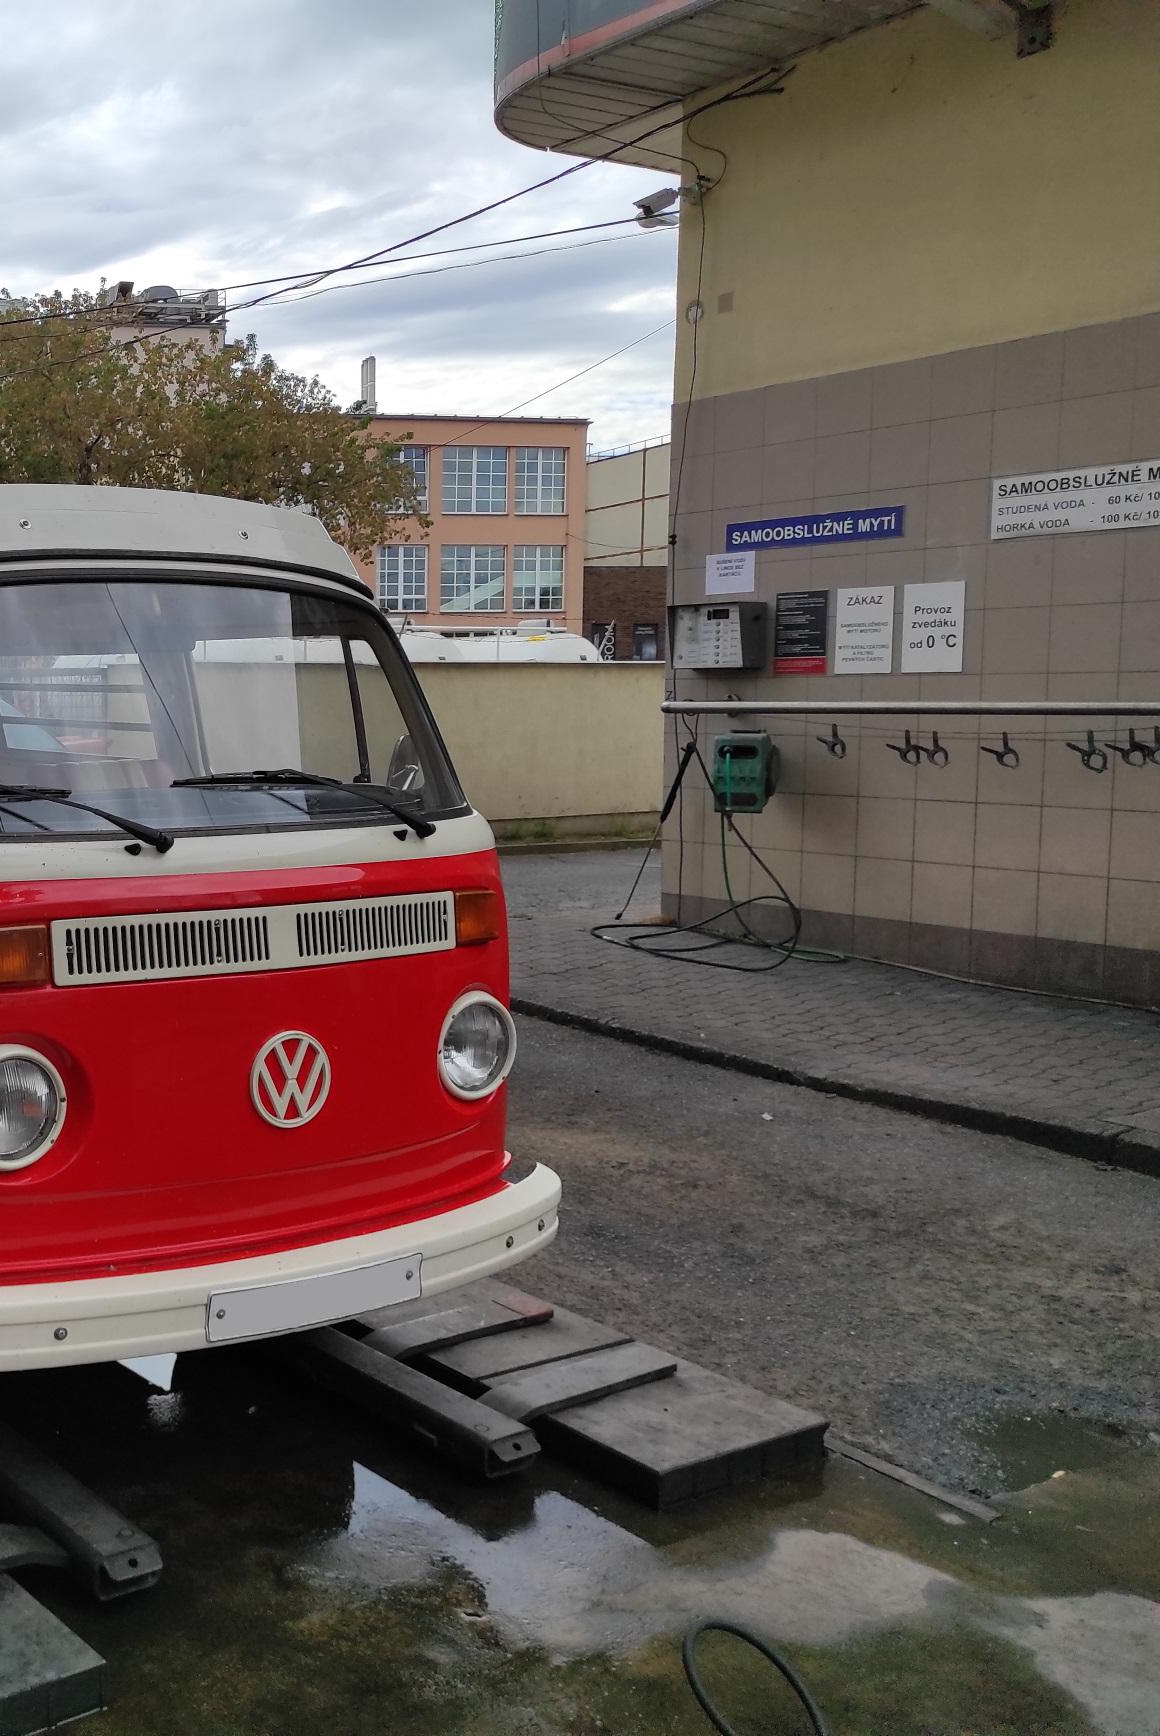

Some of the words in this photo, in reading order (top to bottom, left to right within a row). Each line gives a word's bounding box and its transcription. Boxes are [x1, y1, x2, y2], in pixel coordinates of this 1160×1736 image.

[998, 466, 1142, 497] SAMOOBSLUŽNÉ
[1053, 499, 1085, 511] VODA
[1107, 496, 1121, 505] 60
[732, 518, 853, 545] SAMOOBSLUŽNÉ
[858, 513, 896, 533] MYTÍ
[996, 520, 1035, 533] HORKÁ
[1039, 518, 1070, 529] VODA
[1100, 514, 1120, 524] 100
[847, 594, 883, 607] ZÁKAZ
[914, 605, 952, 615] Provoz
[911, 618, 957, 629] zvedáku
[909, 640, 923, 649] od
[926, 634, 935, 649] 0
